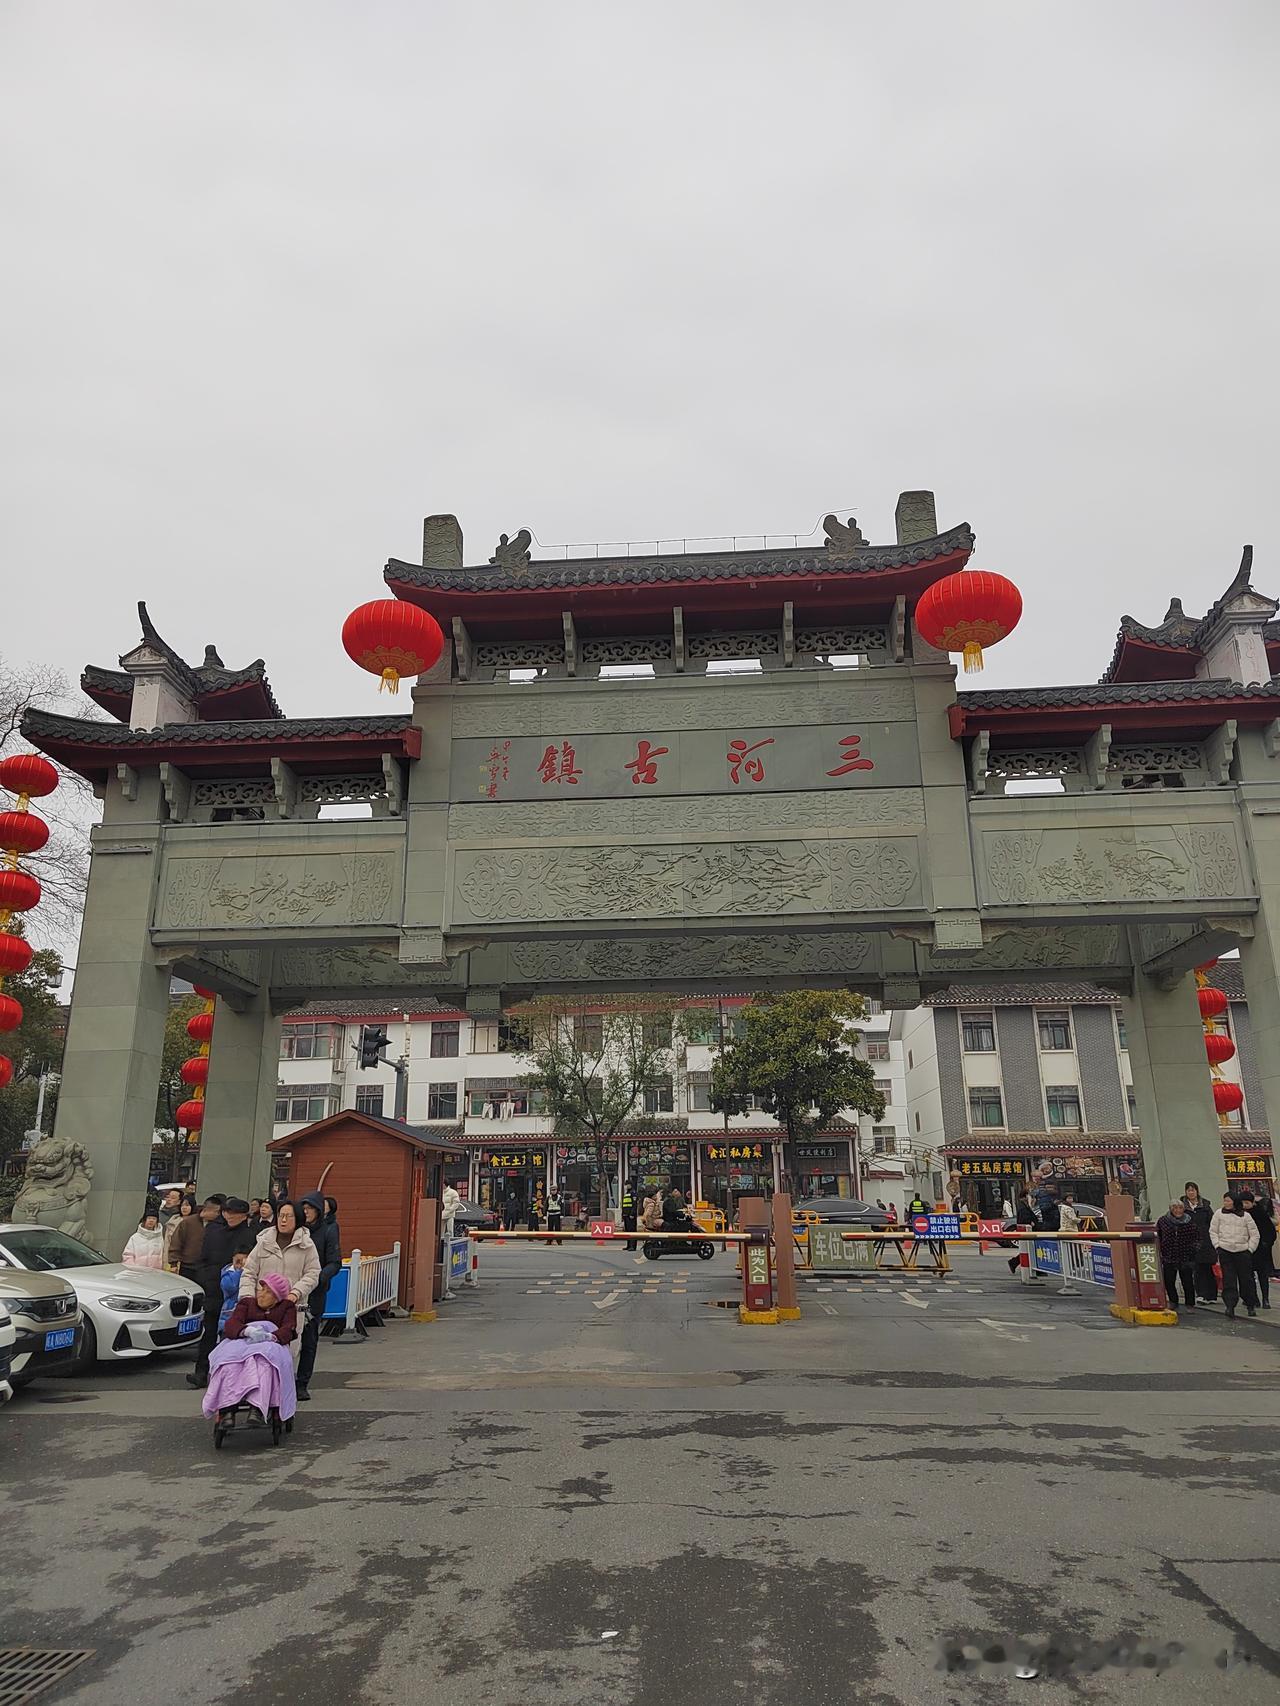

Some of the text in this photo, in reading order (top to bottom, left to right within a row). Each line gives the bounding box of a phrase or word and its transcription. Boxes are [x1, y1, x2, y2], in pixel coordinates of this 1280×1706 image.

[537, 735, 874, 785] 三河古鎮
[961, 1161, 1023, 1175] 老五私房菜馆
[929, 1216, 959, 1225] 禁止驶出
[593, 1225, 612, 1234] 入口
[930, 1225, 959, 1233] 出口右转
[981, 1224, 1001, 1233] 入口
[814, 1232, 869, 1262] 车位已满
[750, 1248, 766, 1283] 此为入口
[1139, 1245, 1157, 1281] 此为入口
